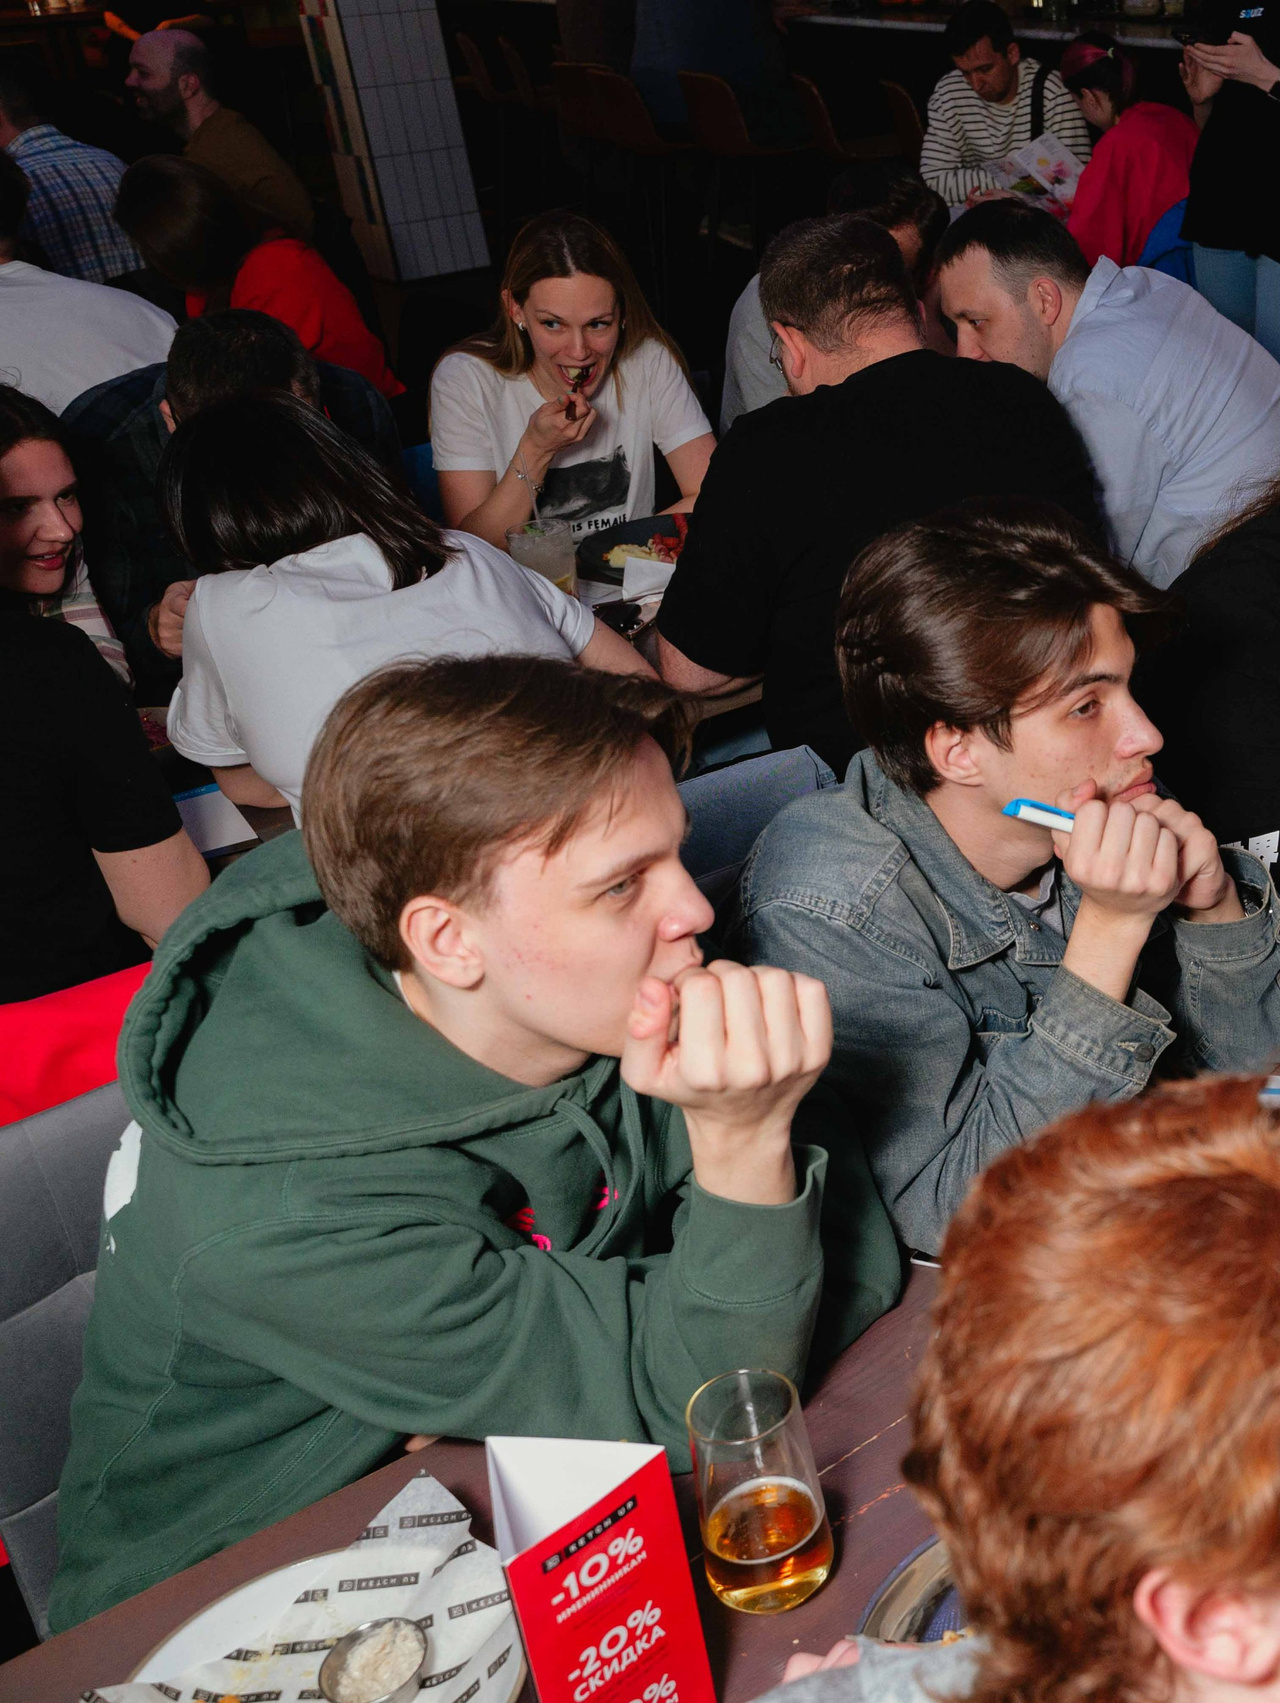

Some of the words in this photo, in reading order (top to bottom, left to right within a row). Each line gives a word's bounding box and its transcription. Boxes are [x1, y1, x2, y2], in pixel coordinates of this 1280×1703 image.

[572, 522, 582, 532] IS
[568, 1517, 612, 1554] KETCH
[617, 1500, 634, 1517] UP
[551, 1527, 644, 1606] -10%
[556, 1550, 648, 1624] ИМЕНИННИКАМ
[568, 1599, 662, 1682] -20%
[573, 1625, 667, 1703] СКИДКА
